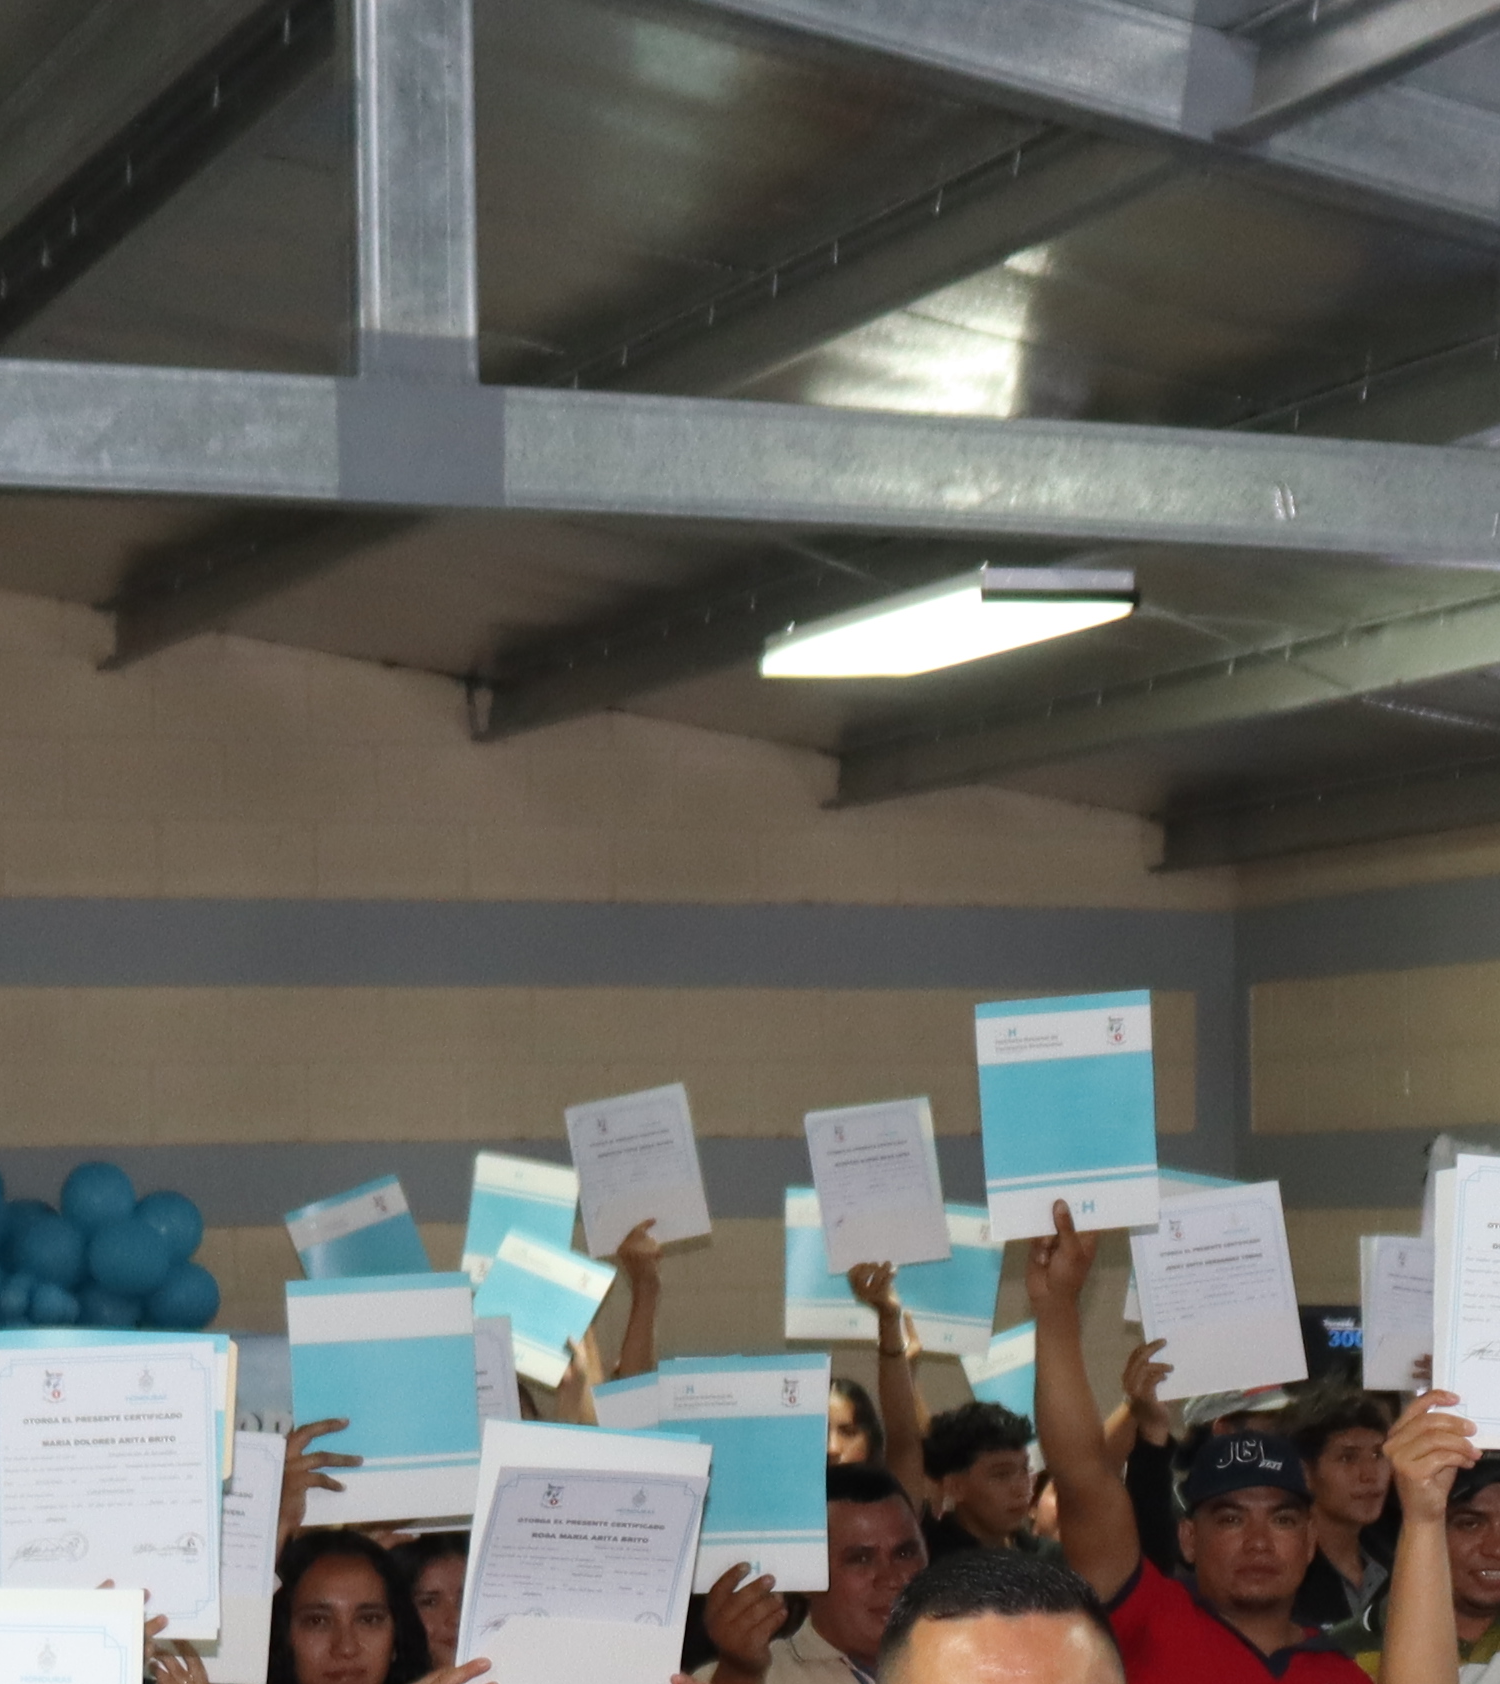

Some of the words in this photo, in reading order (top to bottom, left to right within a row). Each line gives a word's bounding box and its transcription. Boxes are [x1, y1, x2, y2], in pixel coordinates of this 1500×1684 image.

[23, 1416, 61, 1425] OTORGA
[62, 1416, 73, 1424] EL
[75, 1414, 121, 1424] PRESENTE
[124, 1412, 182, 1422] CERTIFICADO
[42, 1439, 71, 1448] MARIA
[74, 1437, 116, 1446] DOLORES
[518, 1517, 551, 1525] OTORGA
[565, 1519, 609, 1528] PRESENTE
[610, 1521, 666, 1531] CERTIFICADO
[559, 1533, 589, 1541] MARIA
